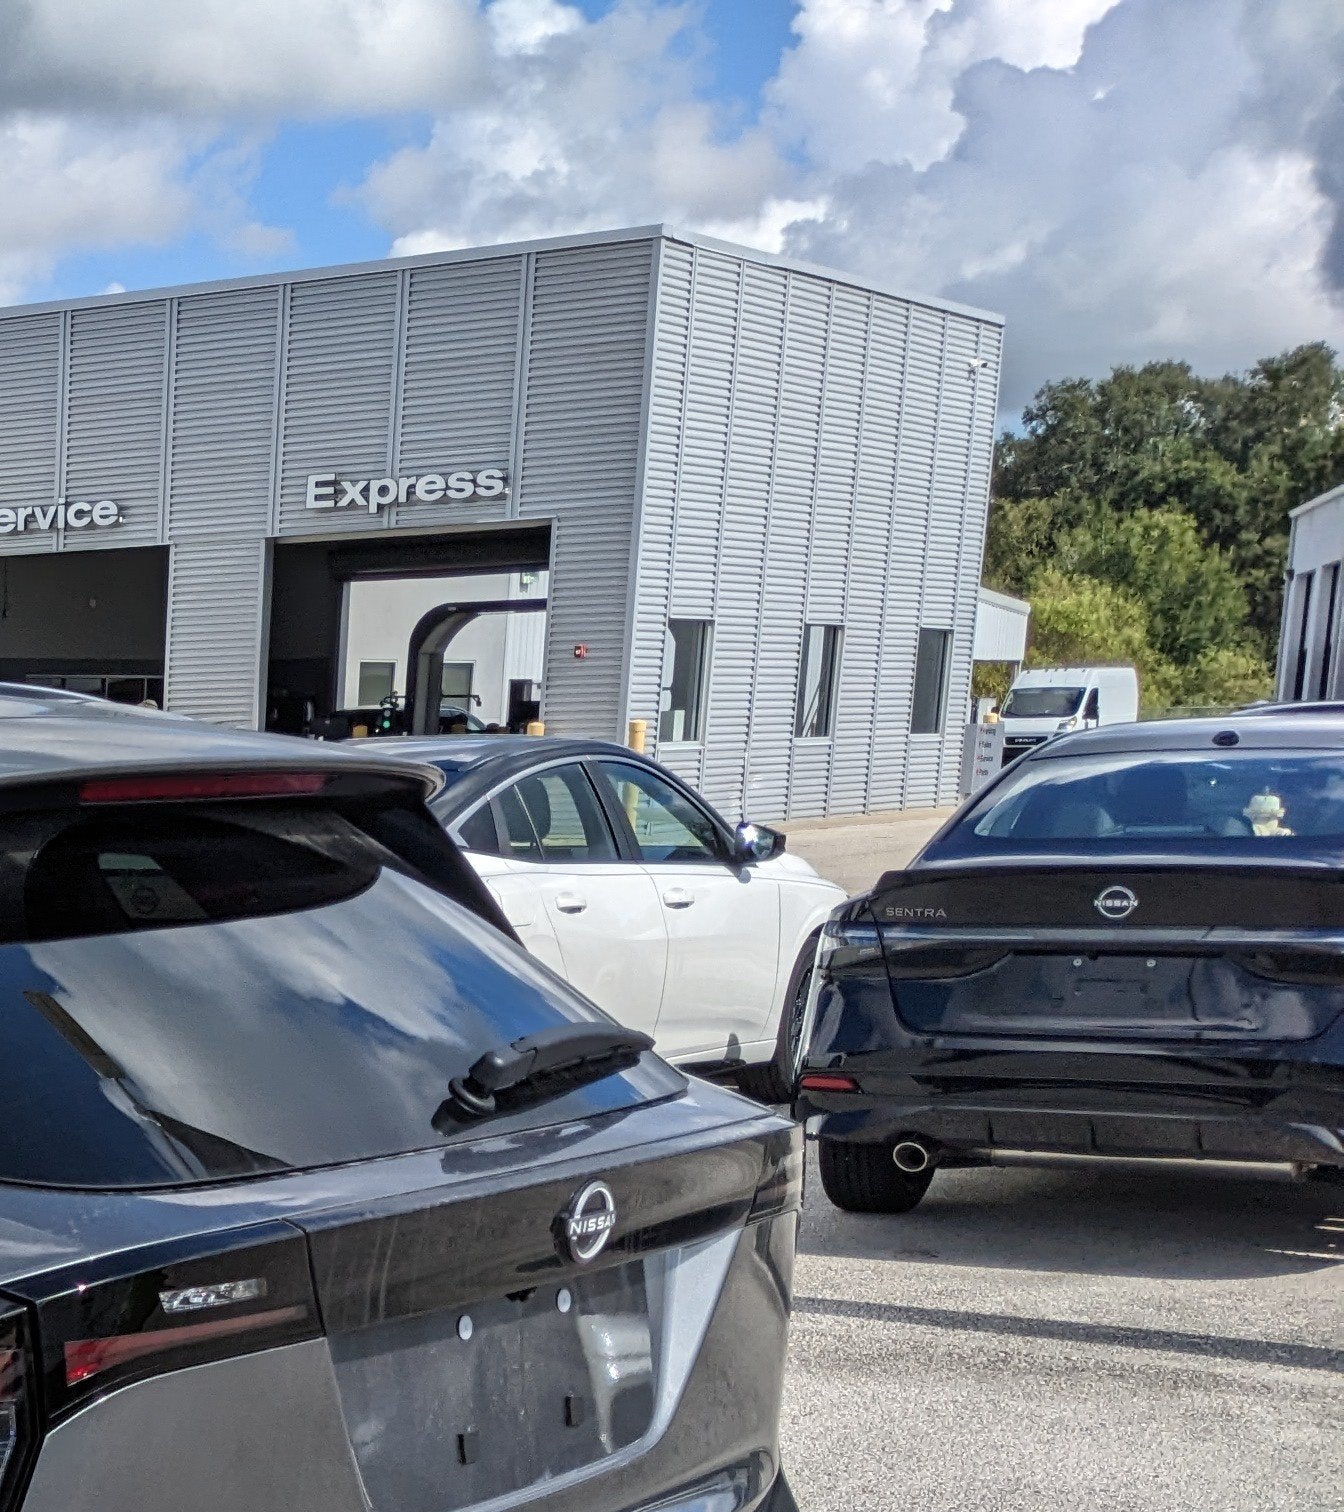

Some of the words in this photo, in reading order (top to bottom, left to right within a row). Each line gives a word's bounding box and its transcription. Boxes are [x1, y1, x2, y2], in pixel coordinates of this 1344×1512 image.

[305, 469, 505, 514] Express
[1093, 898, 1139, 908] NISSAN
[885, 906, 948, 918] SENTRA
[569, 1213, 616, 1235] NISSAN
